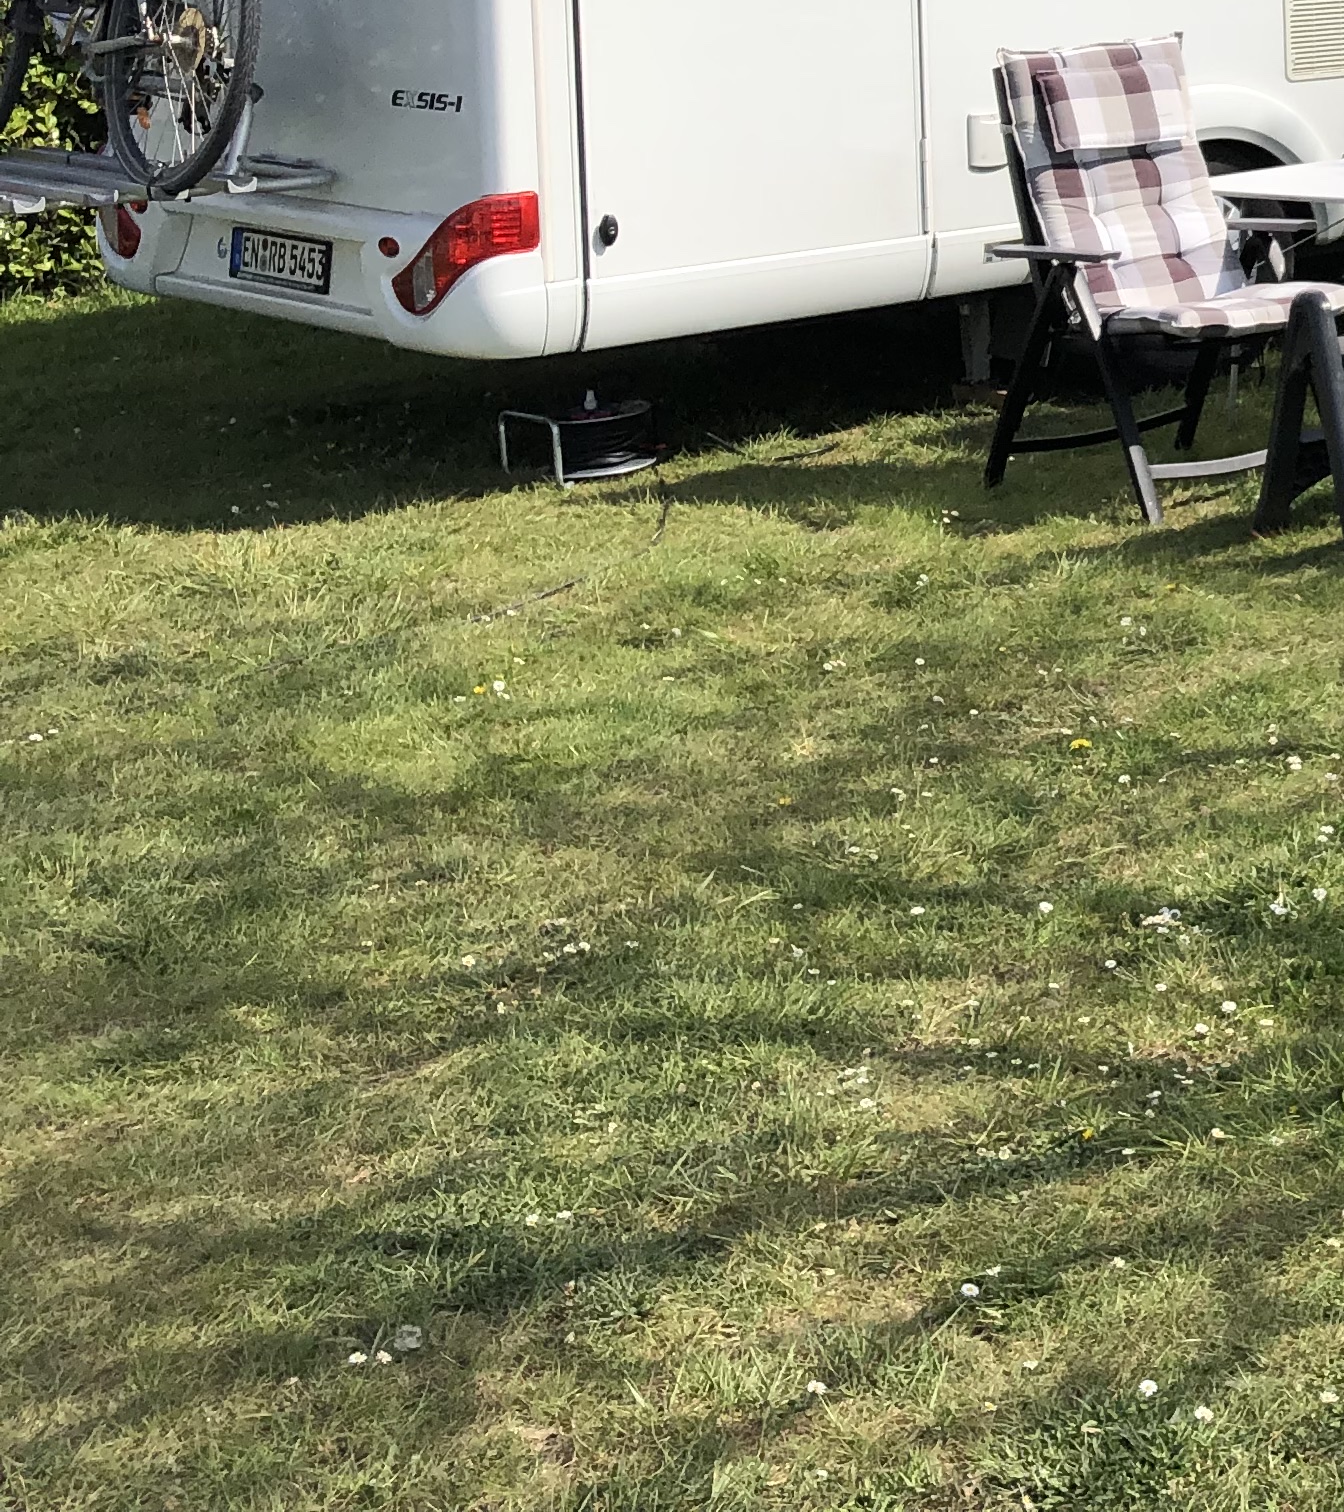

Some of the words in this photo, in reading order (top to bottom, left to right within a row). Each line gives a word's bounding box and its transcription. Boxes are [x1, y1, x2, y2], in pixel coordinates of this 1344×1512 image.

[242, 235, 260, 269] EN
[268, 240, 287, 274] RB
[288, 244, 326, 280] 5453
